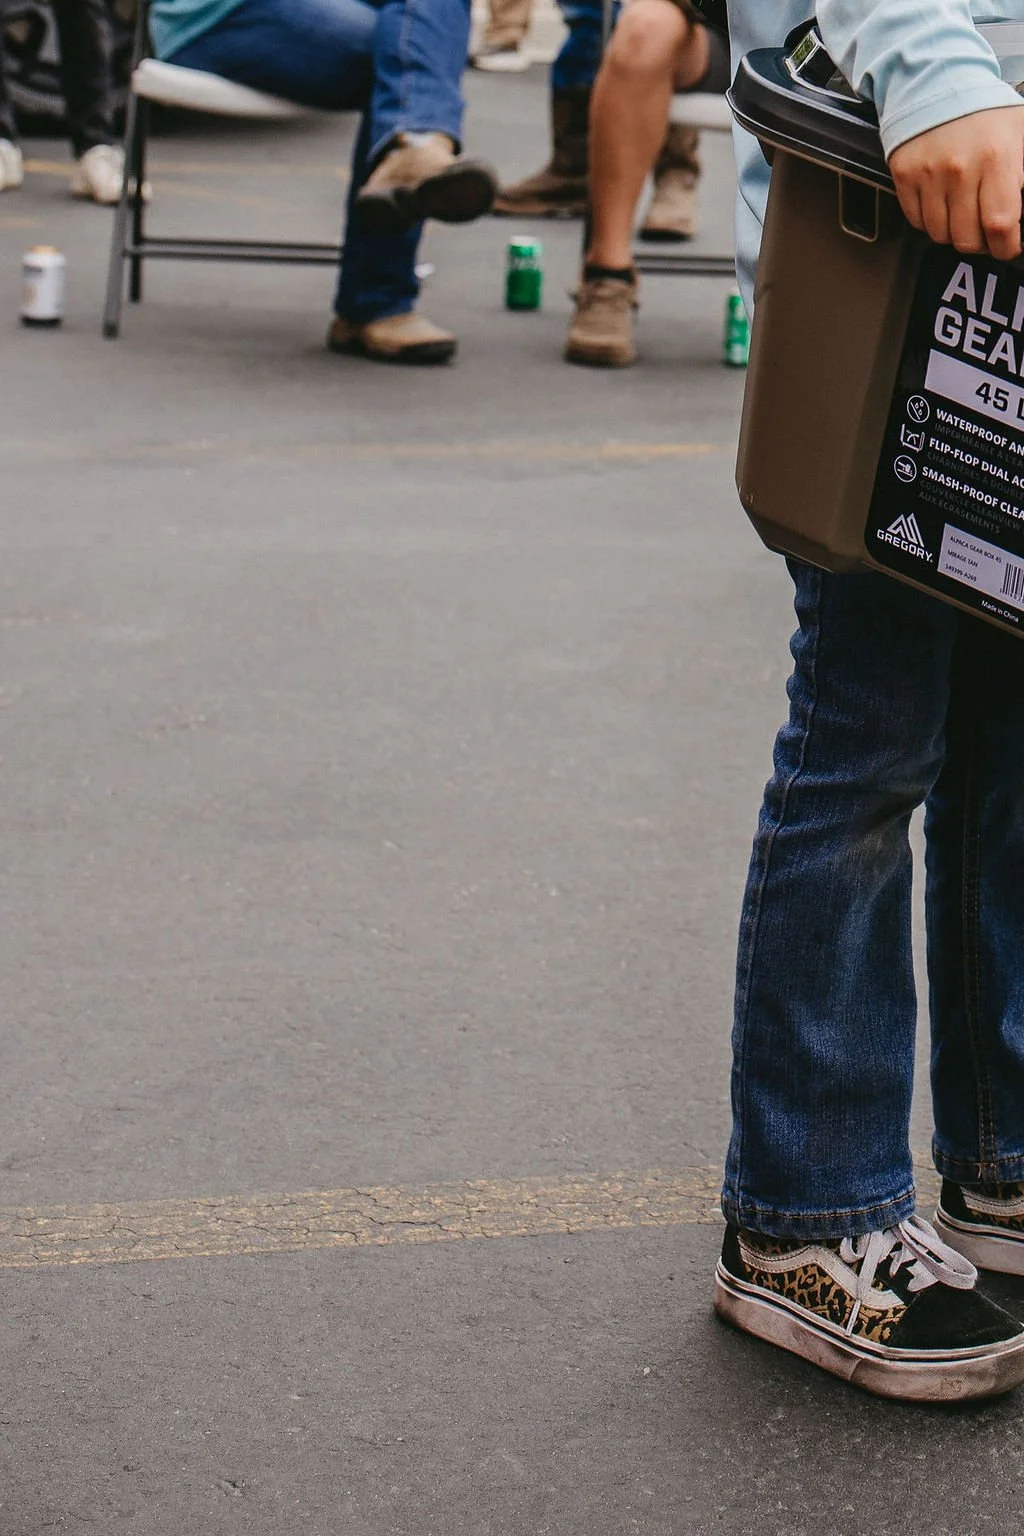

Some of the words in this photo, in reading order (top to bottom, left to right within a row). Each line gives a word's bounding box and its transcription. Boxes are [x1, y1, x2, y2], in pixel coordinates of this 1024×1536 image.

[975, 381, 1009, 411] 45
[936, 408, 1007, 447] WATERPROOF
[929, 437, 979, 466] FLIP-FLOP
[981, 460, 1009, 481] DUAL
[922, 466, 998, 506] SMASH-PROOF
[981, 600, 996, 611] Made
[1003, 610, 1018, 622] China
